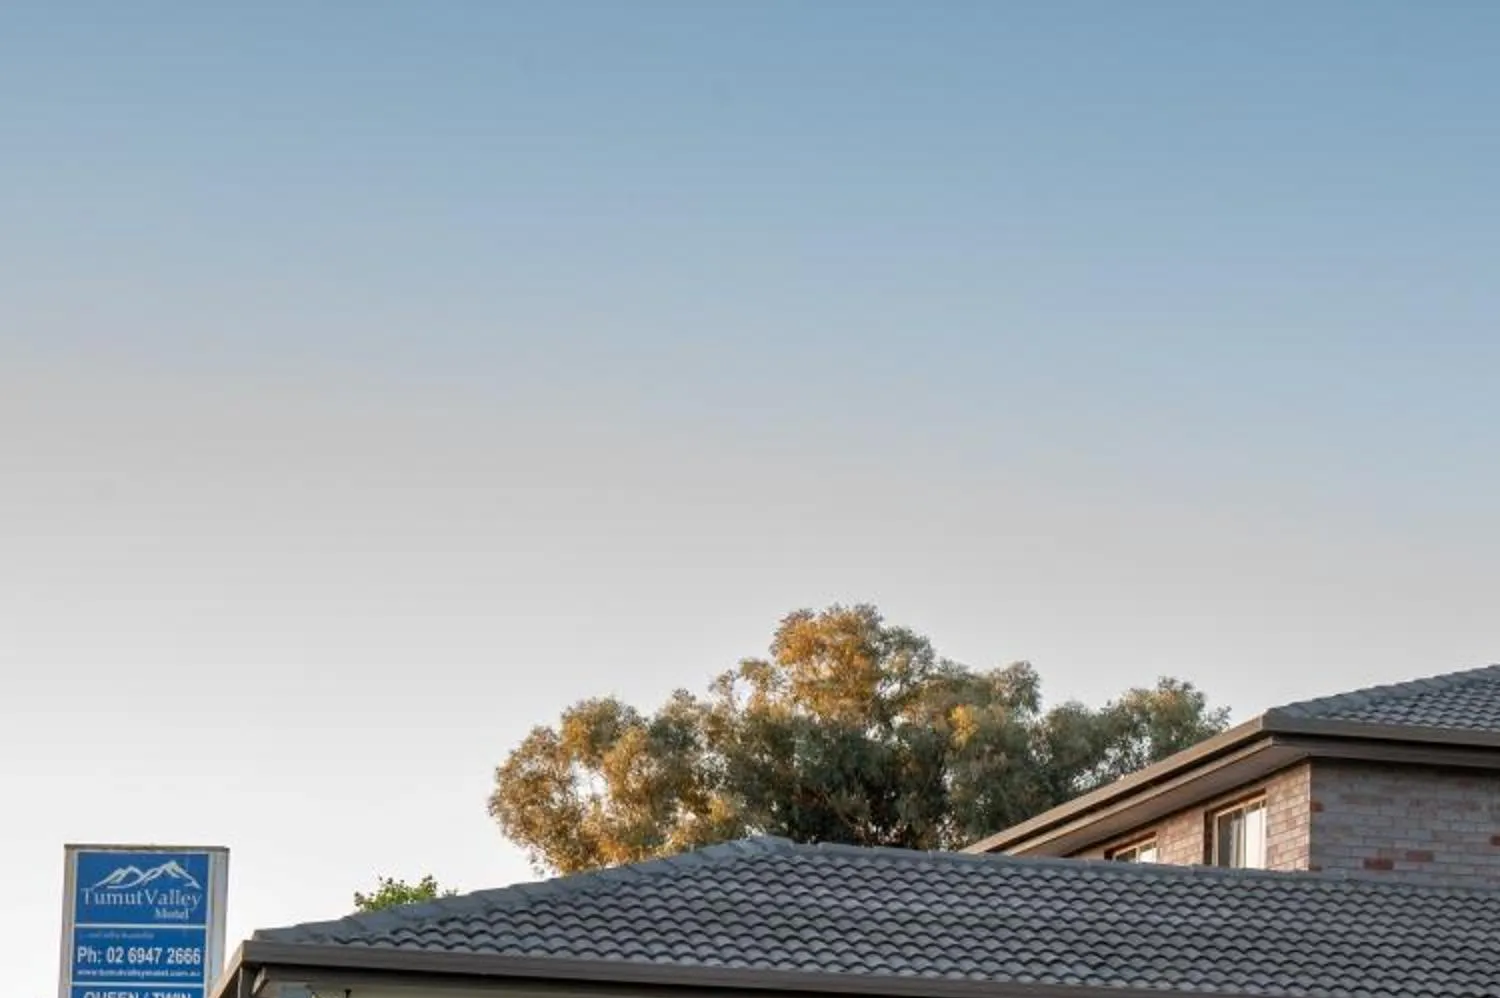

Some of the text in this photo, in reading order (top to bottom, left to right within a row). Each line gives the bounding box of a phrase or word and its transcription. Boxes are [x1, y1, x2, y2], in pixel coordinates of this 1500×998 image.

[77, 945, 201, 965] Ph: 02 6947 2666
